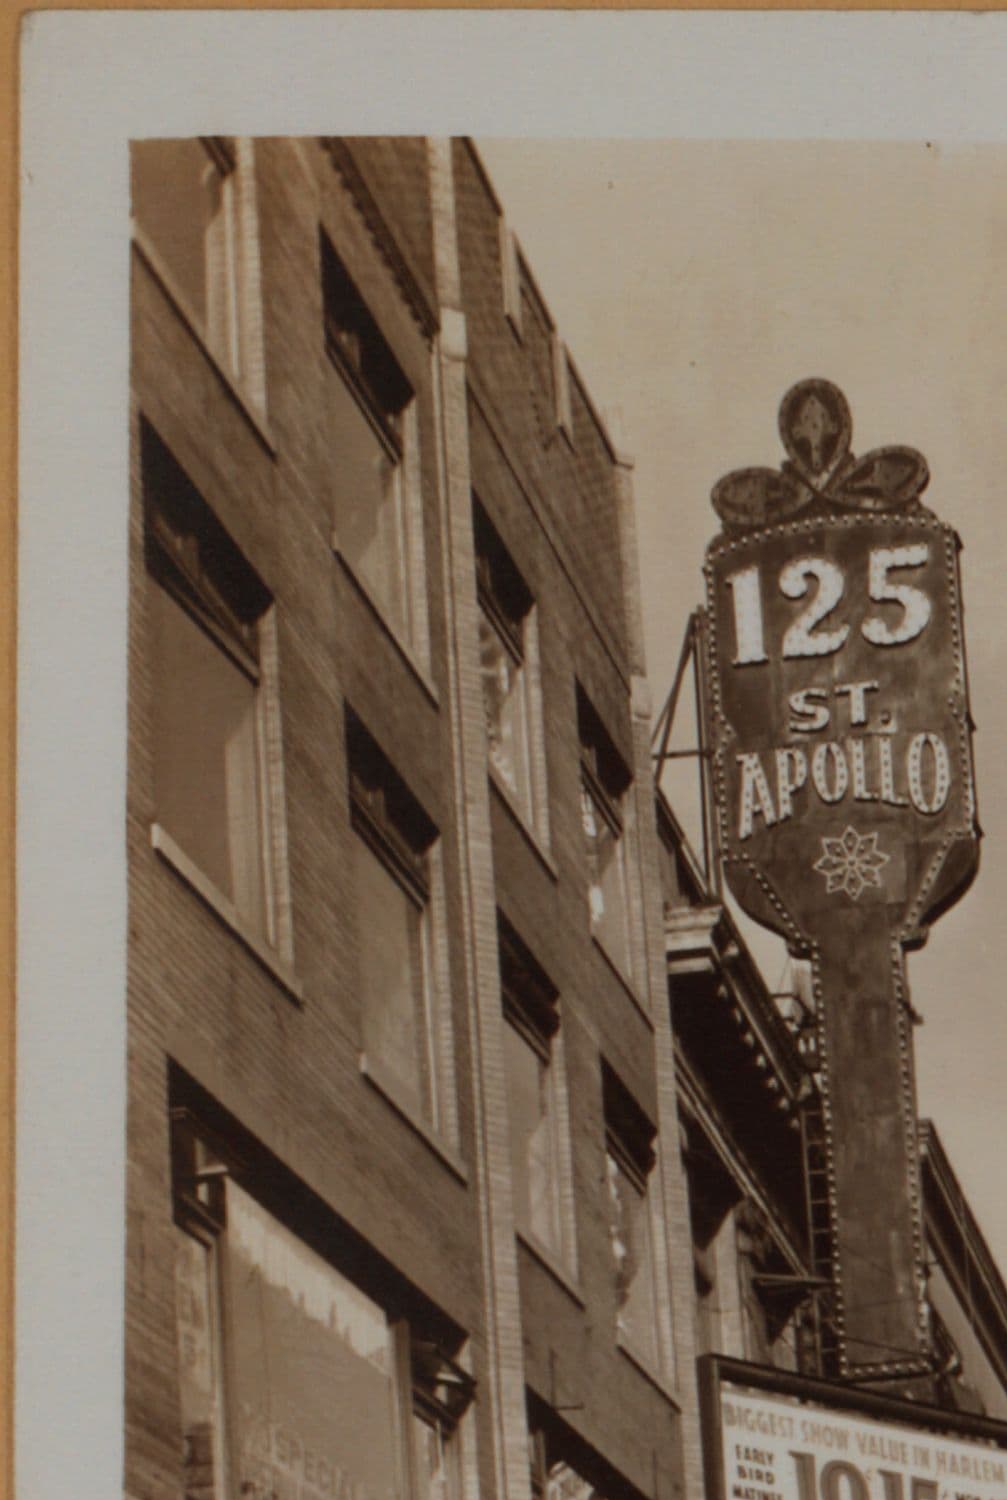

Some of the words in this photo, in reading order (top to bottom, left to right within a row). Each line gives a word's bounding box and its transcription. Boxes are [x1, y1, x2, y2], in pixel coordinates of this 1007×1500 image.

[724, 542, 933, 666] 125
[788, 679, 896, 735] ST.
[735, 732, 951, 840] APOLLO
[722, 1402, 795, 1439] BIGGEST
[799, 1418, 850, 1451] SHOW
[856, 1428, 909, 1466] VALUE
[911, 1446, 932, 1469] IN
[934, 1449, 1007, 1485] HARLEM
[735, 1443, 775, 1466] EARLY
[736, 1466, 776, 1486] BIRD
